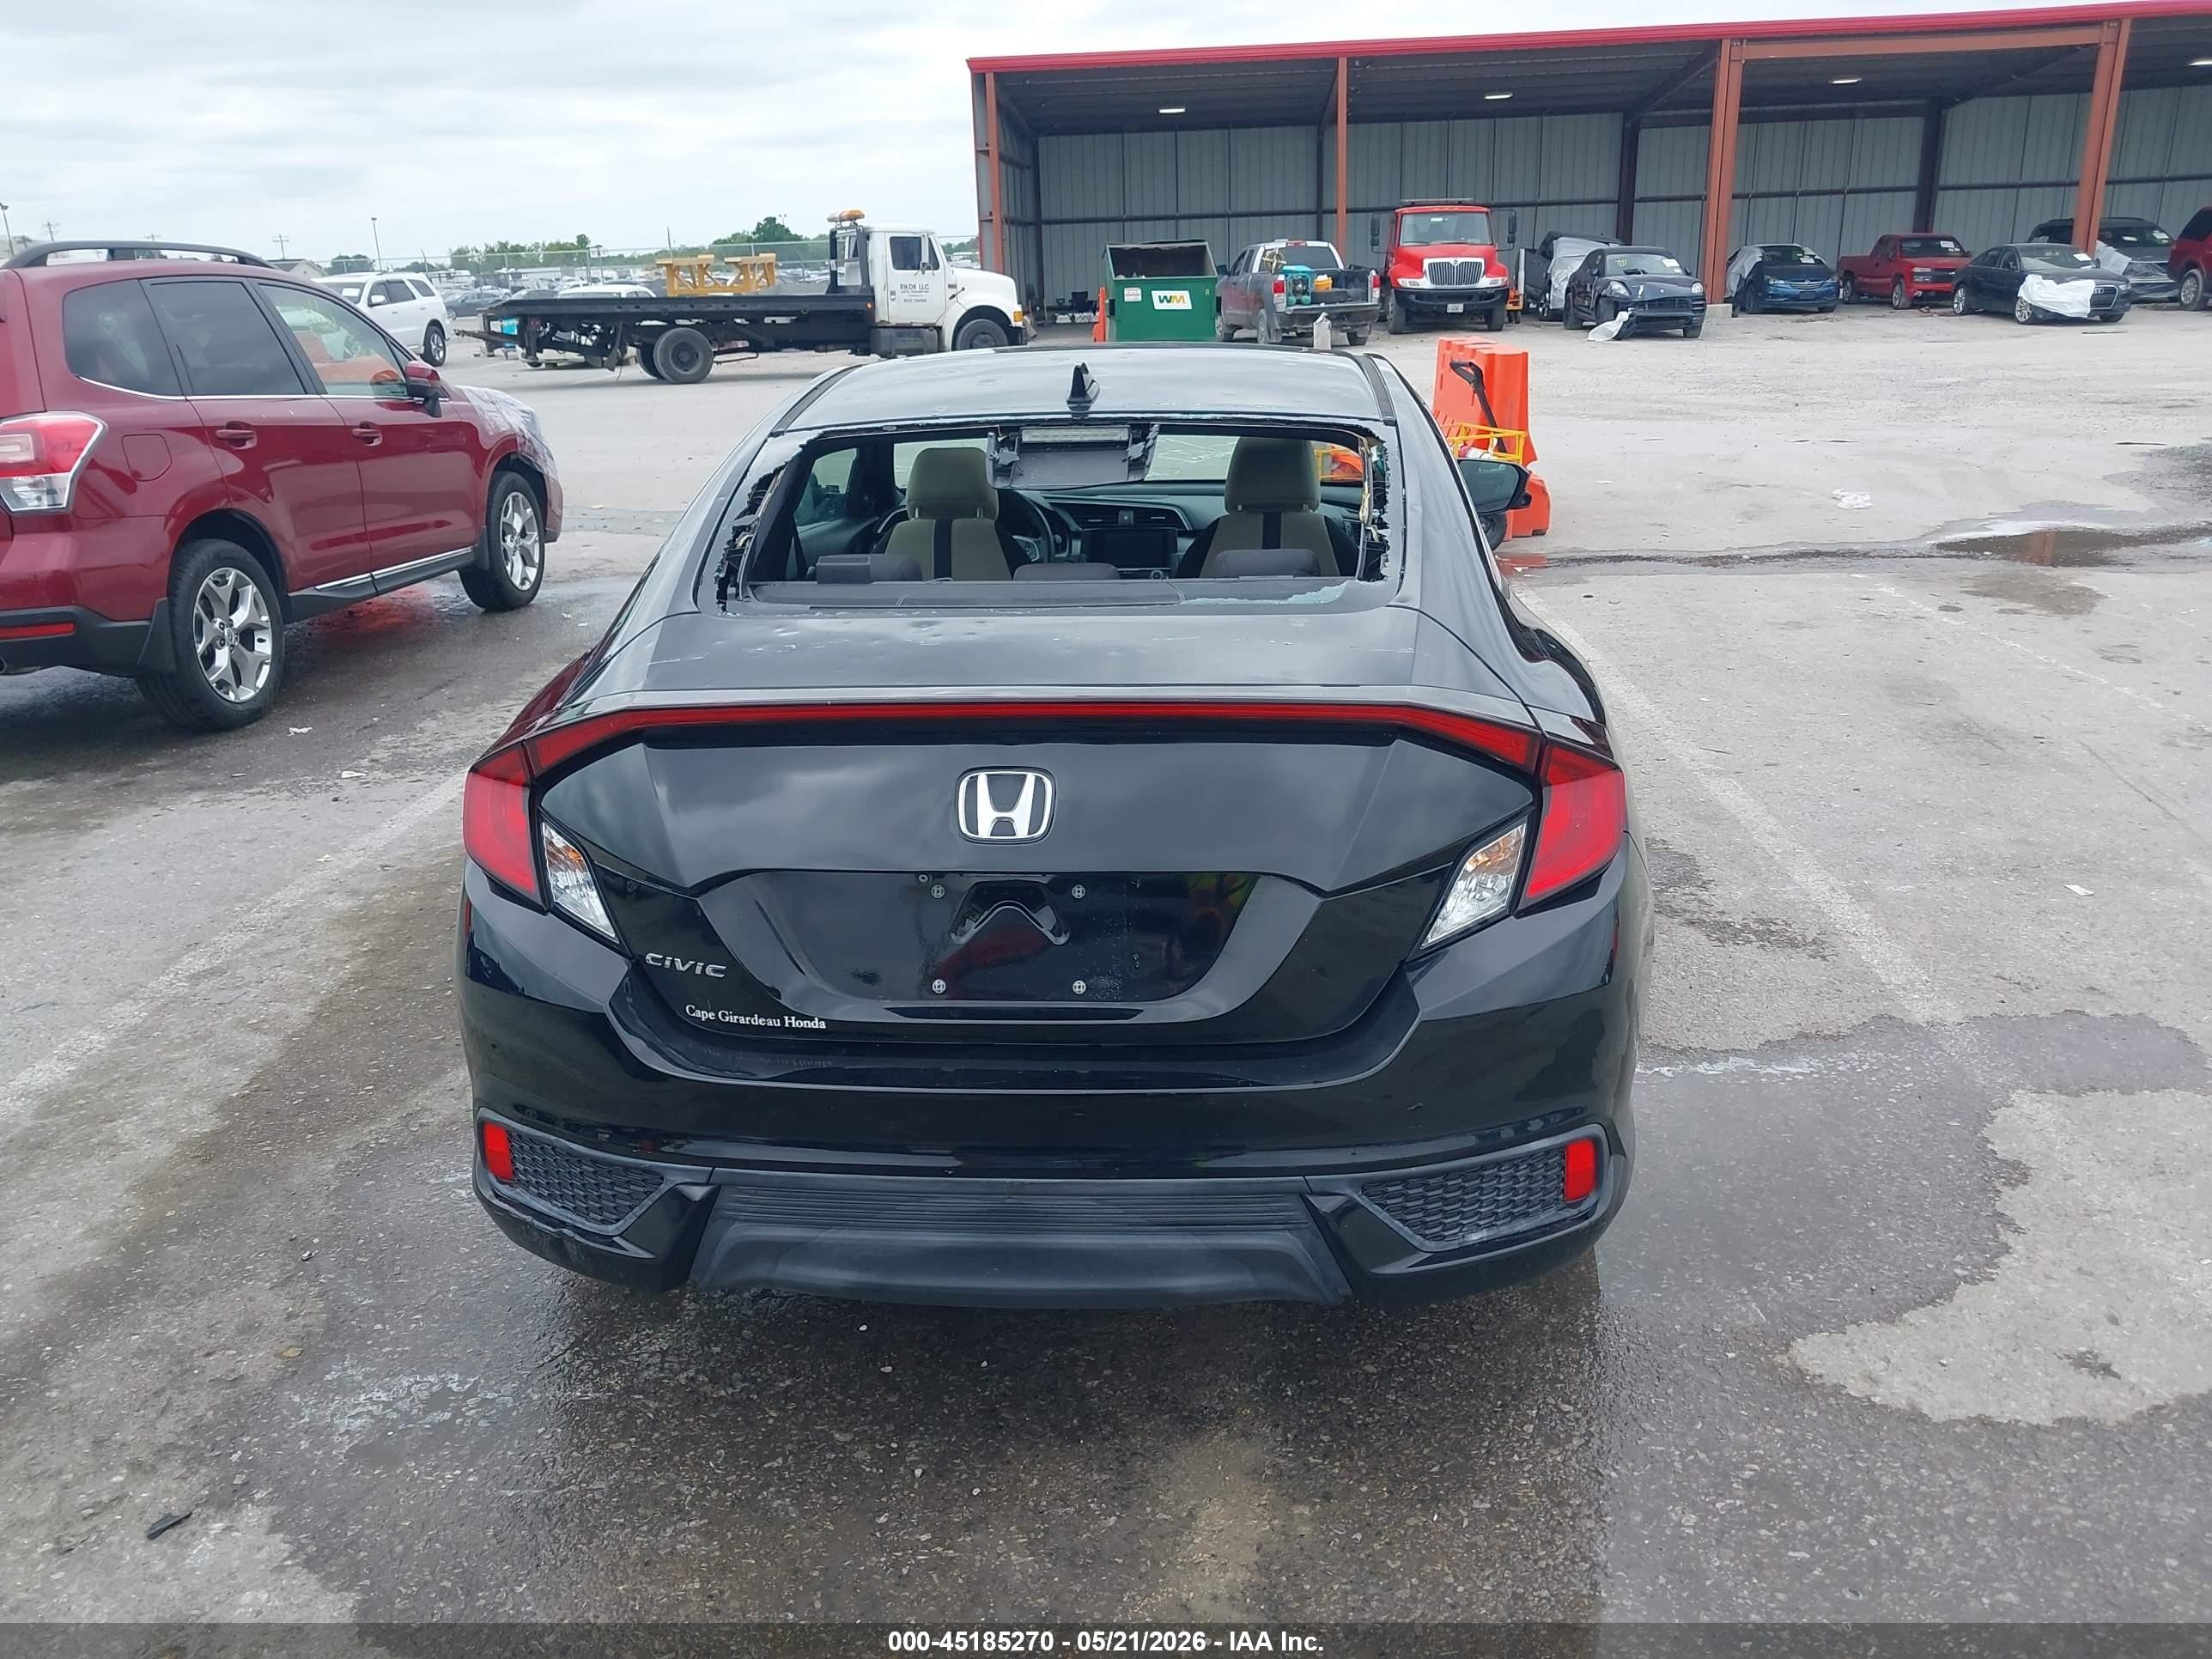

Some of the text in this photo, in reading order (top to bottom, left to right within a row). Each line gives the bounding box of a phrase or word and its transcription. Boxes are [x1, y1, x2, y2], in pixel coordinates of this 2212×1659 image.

[1158, 295, 1186, 304] WM
[645, 952, 727, 978] CIVIC
[685, 1005, 827, 1030] Cape Girardeau Honda
